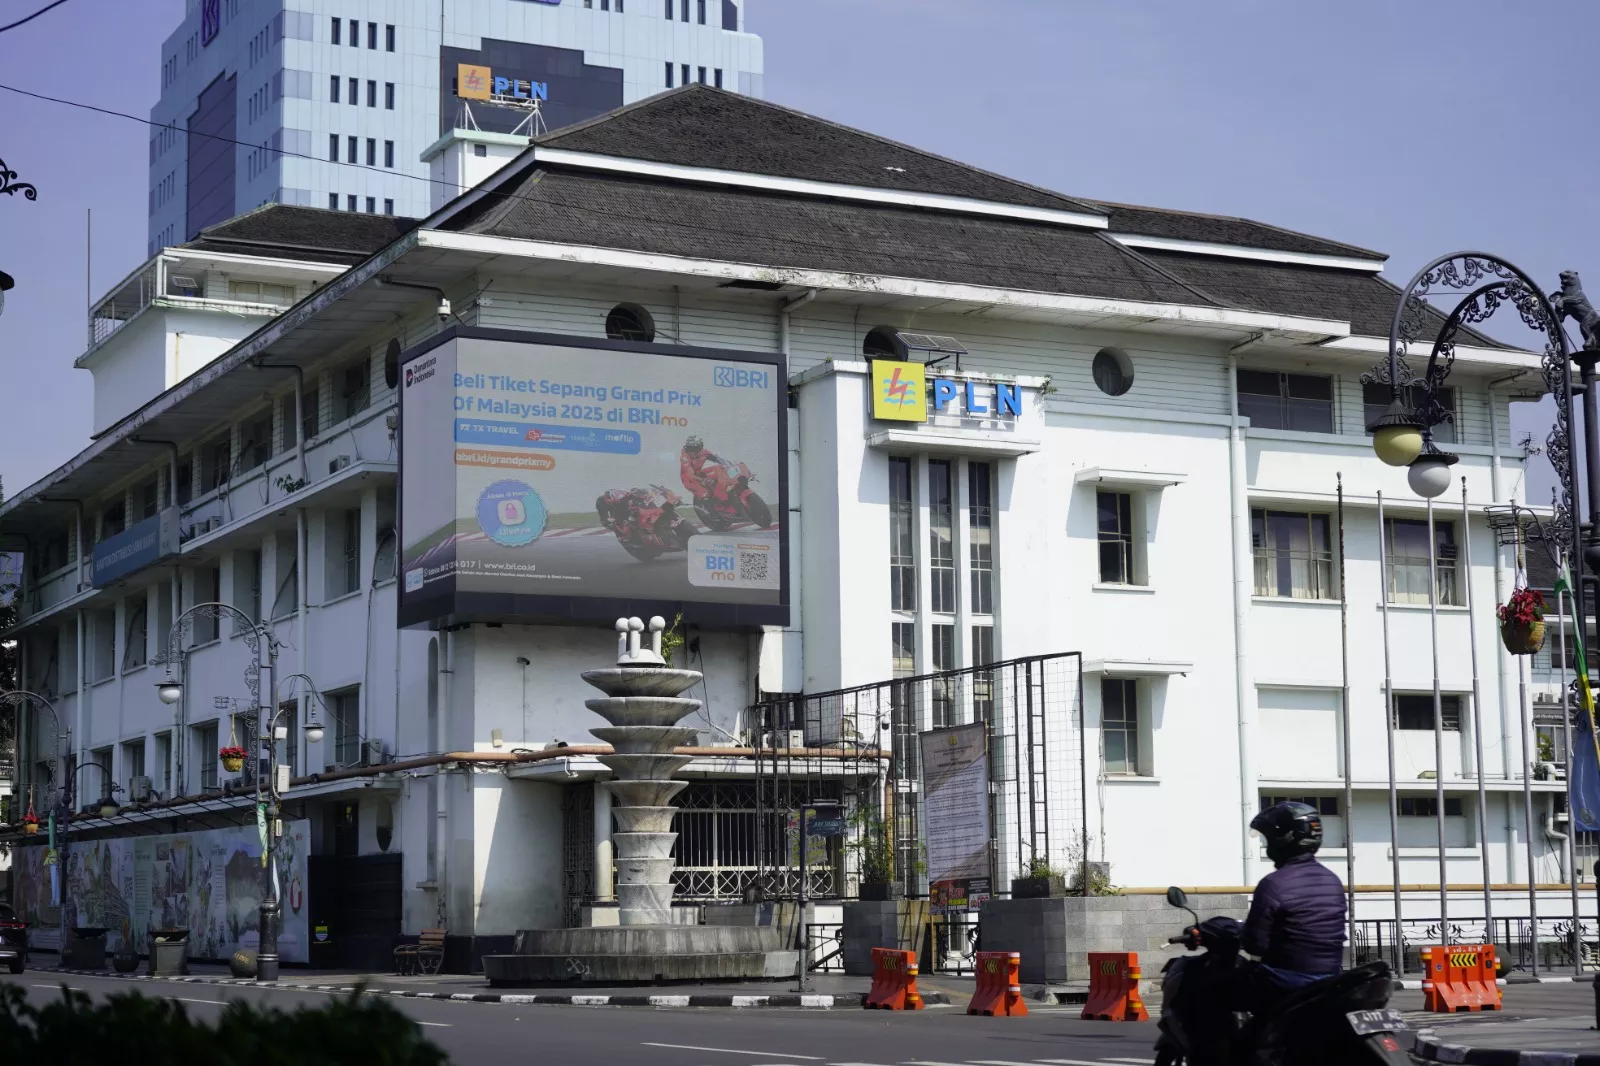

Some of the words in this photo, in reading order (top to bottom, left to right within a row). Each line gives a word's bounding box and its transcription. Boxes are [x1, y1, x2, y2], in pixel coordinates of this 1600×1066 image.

[494, 76, 548, 100] PLN
[413, 357, 437, 374] Danantara
[413, 368, 435, 385] Indonesia
[735, 369, 768, 389] BRI
[453, 373, 485, 390] Beli
[488, 375, 536, 393] Tiket
[539, 379, 607, 402] Sepang
[611, 385, 664, 404] Grand
[668, 390, 702, 406] Prix
[934, 378, 1023, 416] PLN
[453, 395, 473, 412] Of
[477, 398, 557, 419] Malaysia
[561, 404, 603, 421] 2025
[607, 408, 623, 423] di
[628, 407, 688, 427] BRImo
[472, 424, 484, 432] TX
[486, 425, 520, 435] TRAVEL
[456, 451, 551, 469] bbri.id/grandprixmy
[460, 560, 476, 568] 017
[484, 562, 536, 571] www.bri.co.id
[705, 555, 735, 571] BRI
[711, 571, 736, 581] mo
